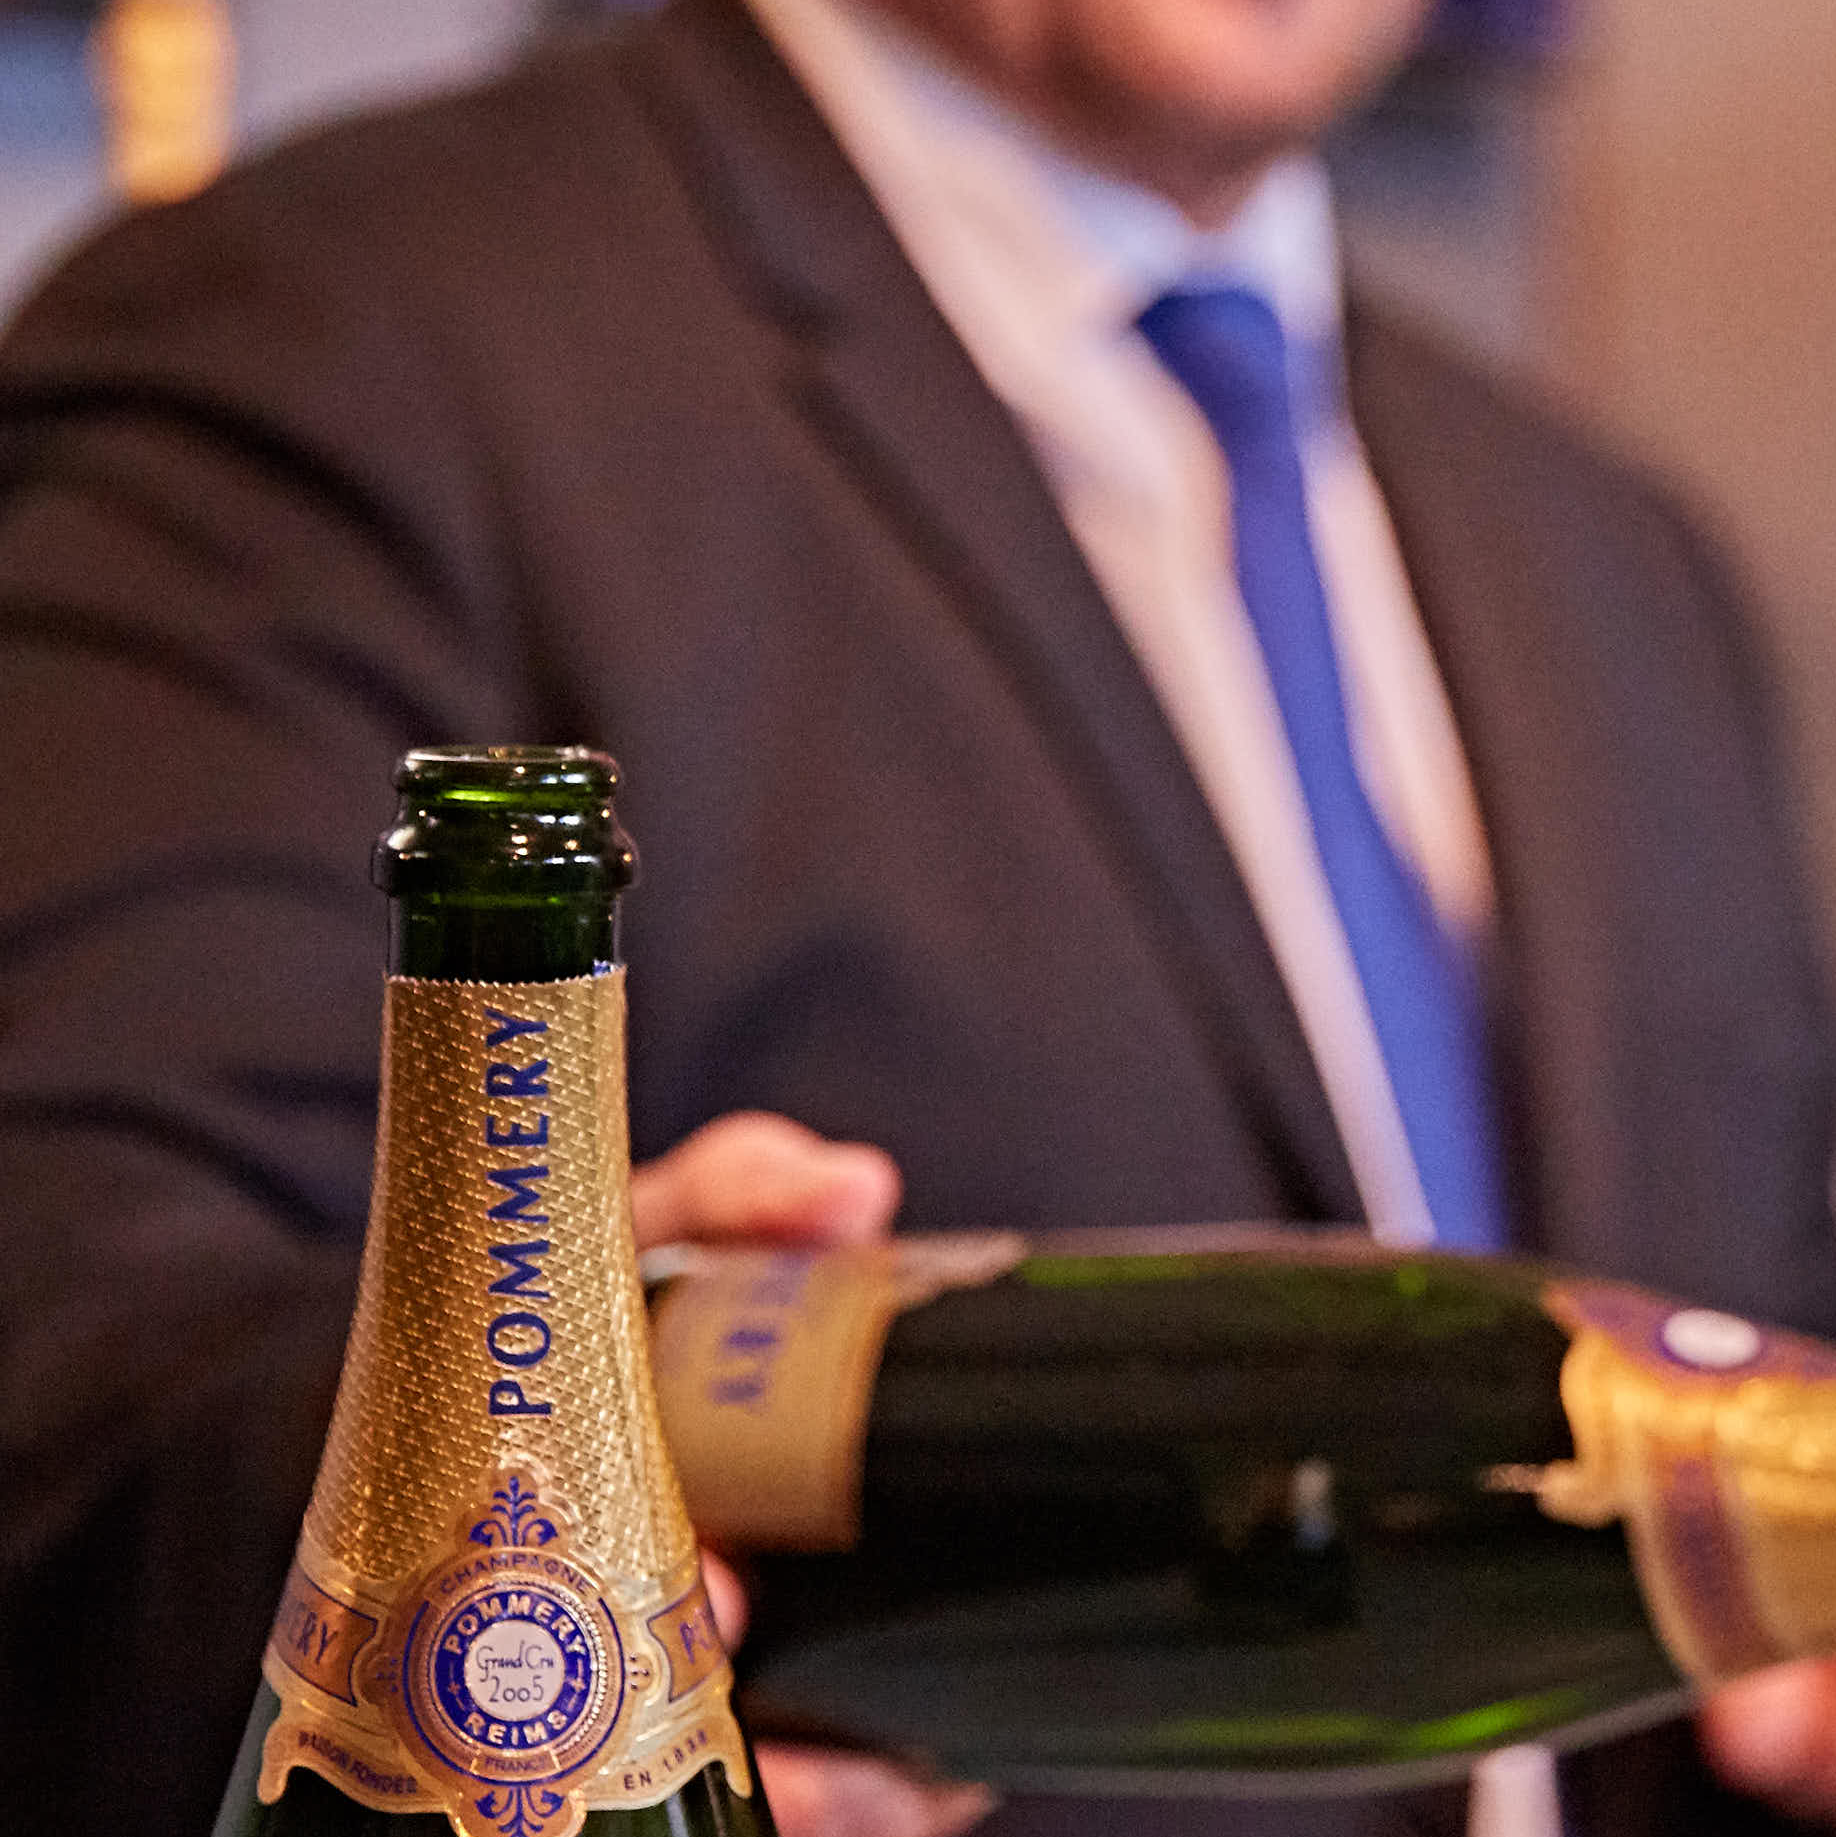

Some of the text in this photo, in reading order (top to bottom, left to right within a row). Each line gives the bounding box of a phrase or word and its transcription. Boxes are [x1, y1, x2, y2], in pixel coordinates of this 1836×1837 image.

[484, 1008, 552, 1416] POMMERY
[440, 1553, 591, 1594] CHAMPAGNE
[444, 1593, 586, 1656] POMMERY
[475, 1640, 554, 1682] Grand Cru
[488, 1675, 544, 1703] 2005
[464, 1709, 568, 1746] REIMS
[623, 1771, 652, 1791] EN
